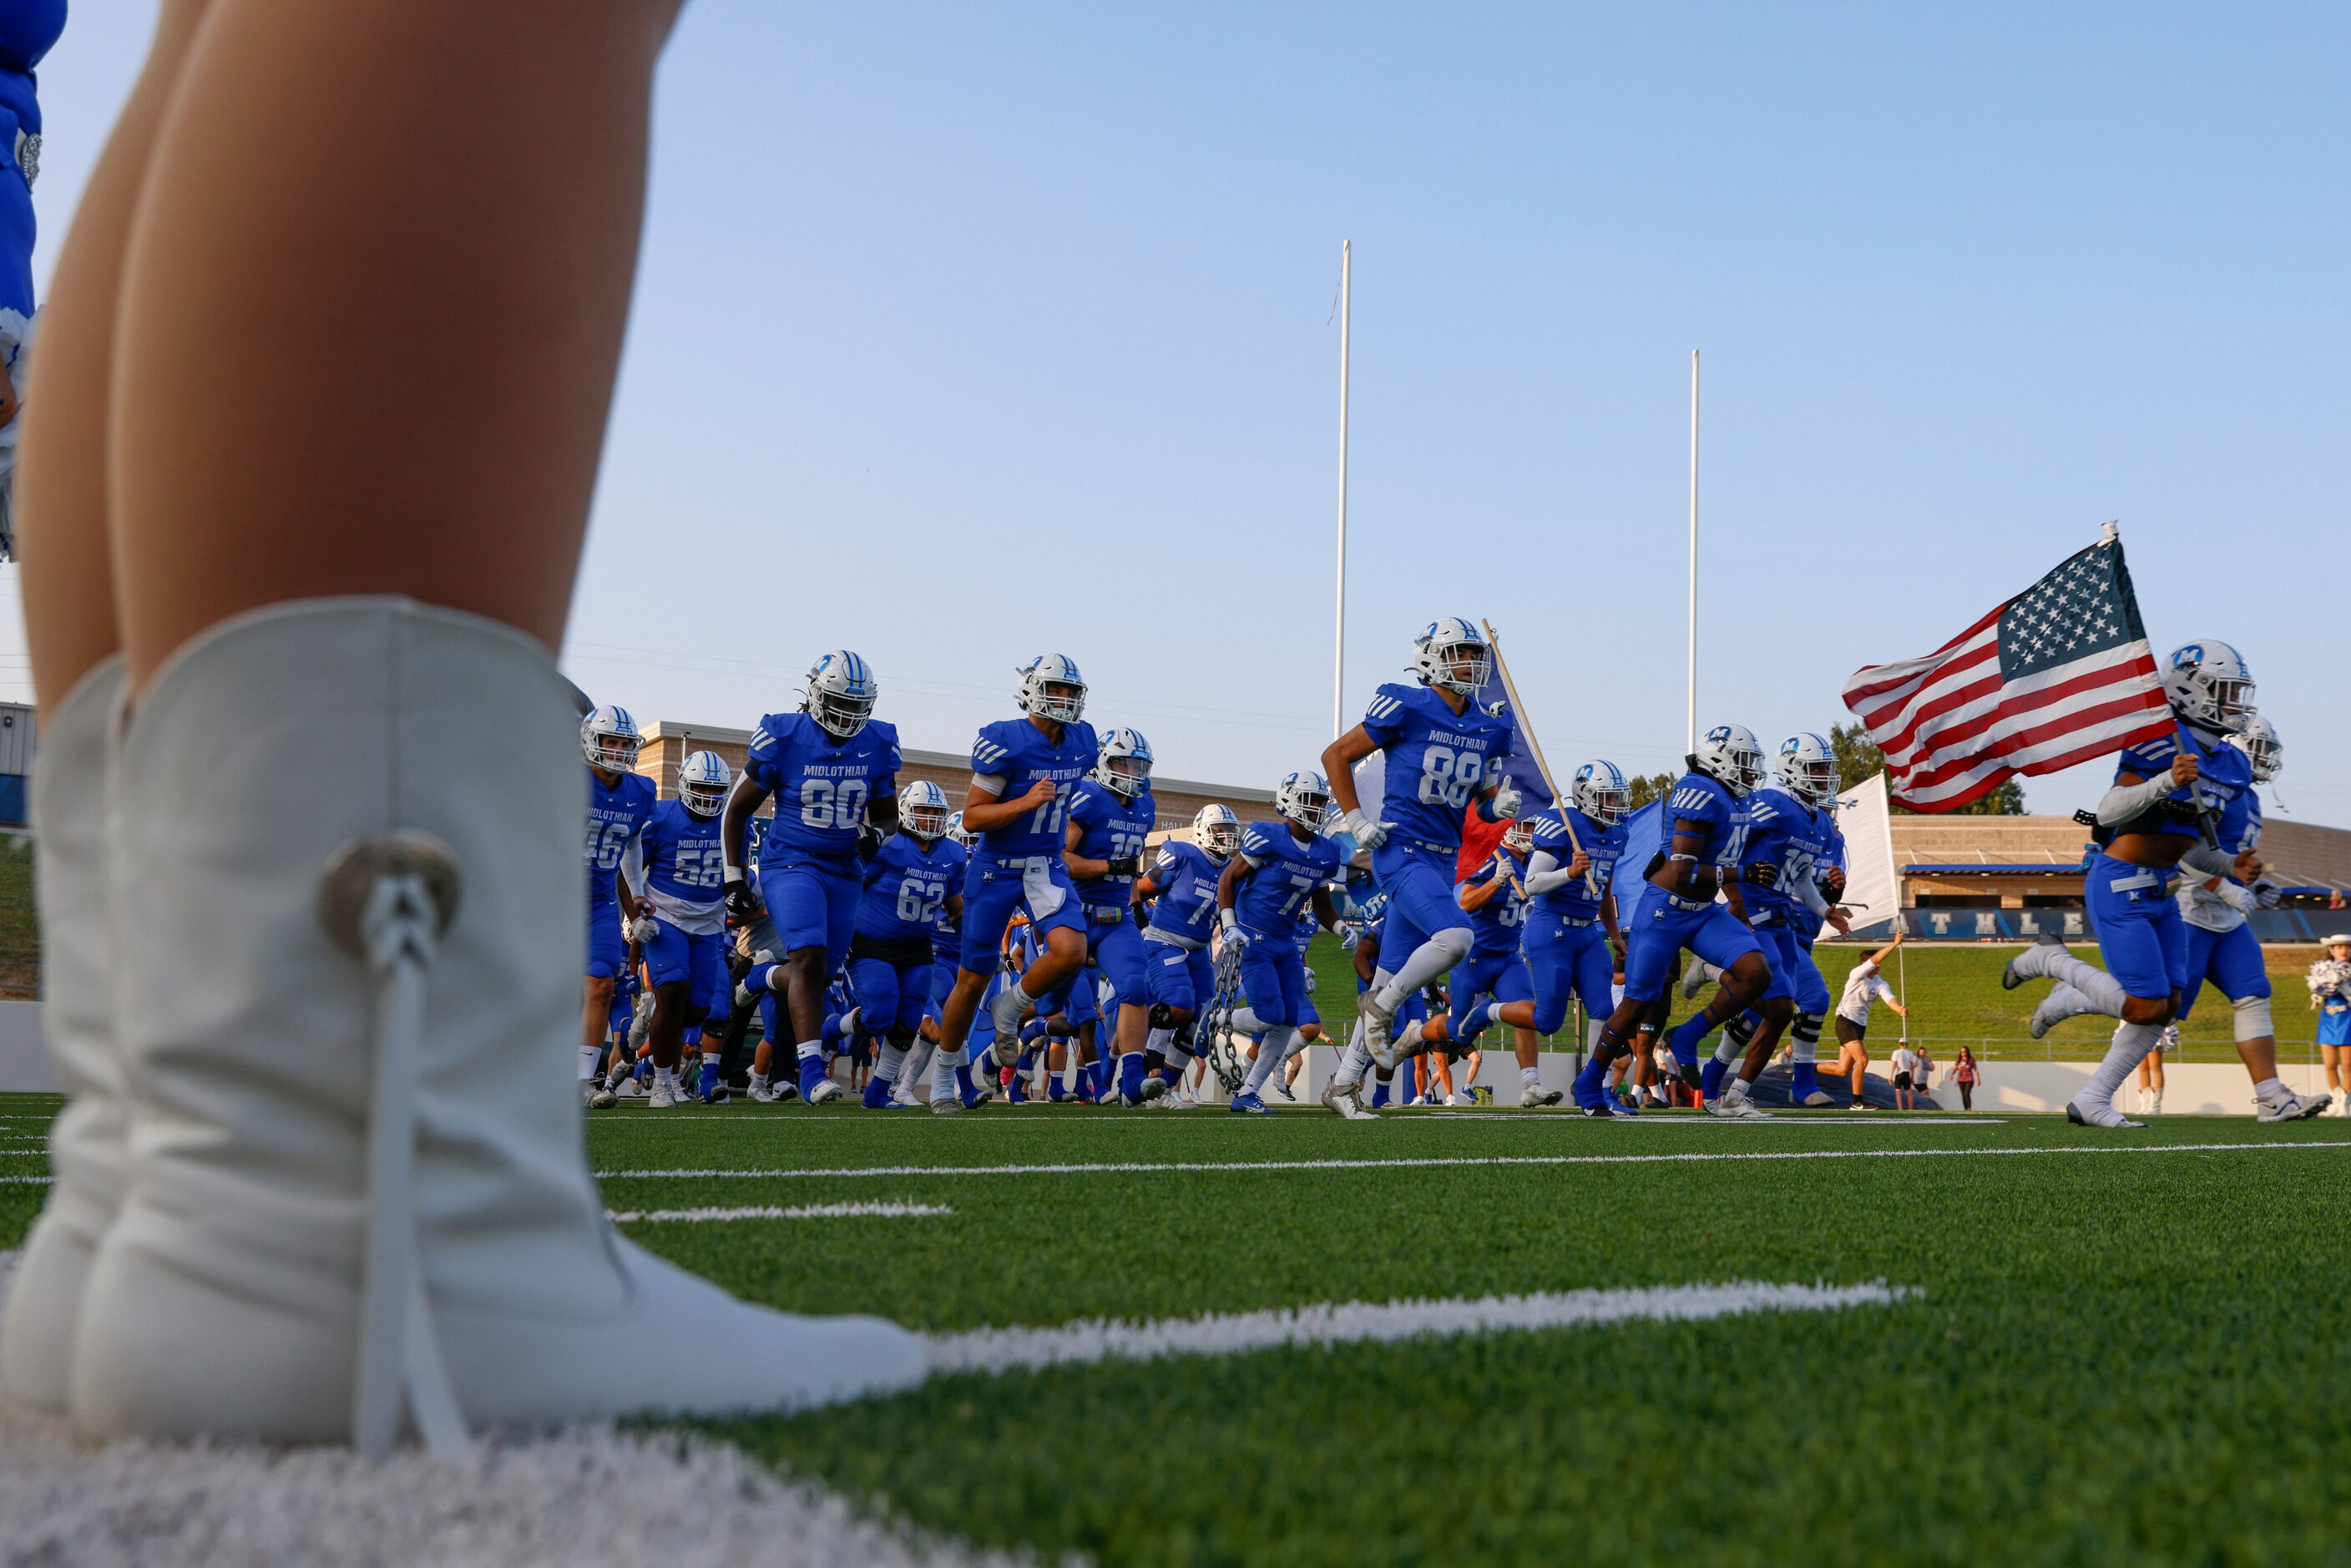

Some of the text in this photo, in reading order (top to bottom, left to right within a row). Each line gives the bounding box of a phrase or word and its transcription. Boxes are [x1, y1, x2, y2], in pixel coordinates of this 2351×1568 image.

[1428, 730, 1487, 750] MIDLOTHIAN
[803, 765, 868, 776] MIDLOTHIAN
[1028, 766, 1082, 780] MIDLOTHIAN
[1418, 745, 1482, 808] 88
[801, 778, 867, 829] 80
[1030, 782, 1072, 834] 11
[1107, 818, 1148, 833] MIDLOTHIAN
[673, 849, 723, 888] 58
[904, 867, 949, 882] MIDLOTHIAN
[1282, 861, 1324, 878] MIDLOTHIAN
[897, 878, 944, 923] 62
[1278, 874, 1313, 915] 7
[1499, 888, 1529, 928] 5
